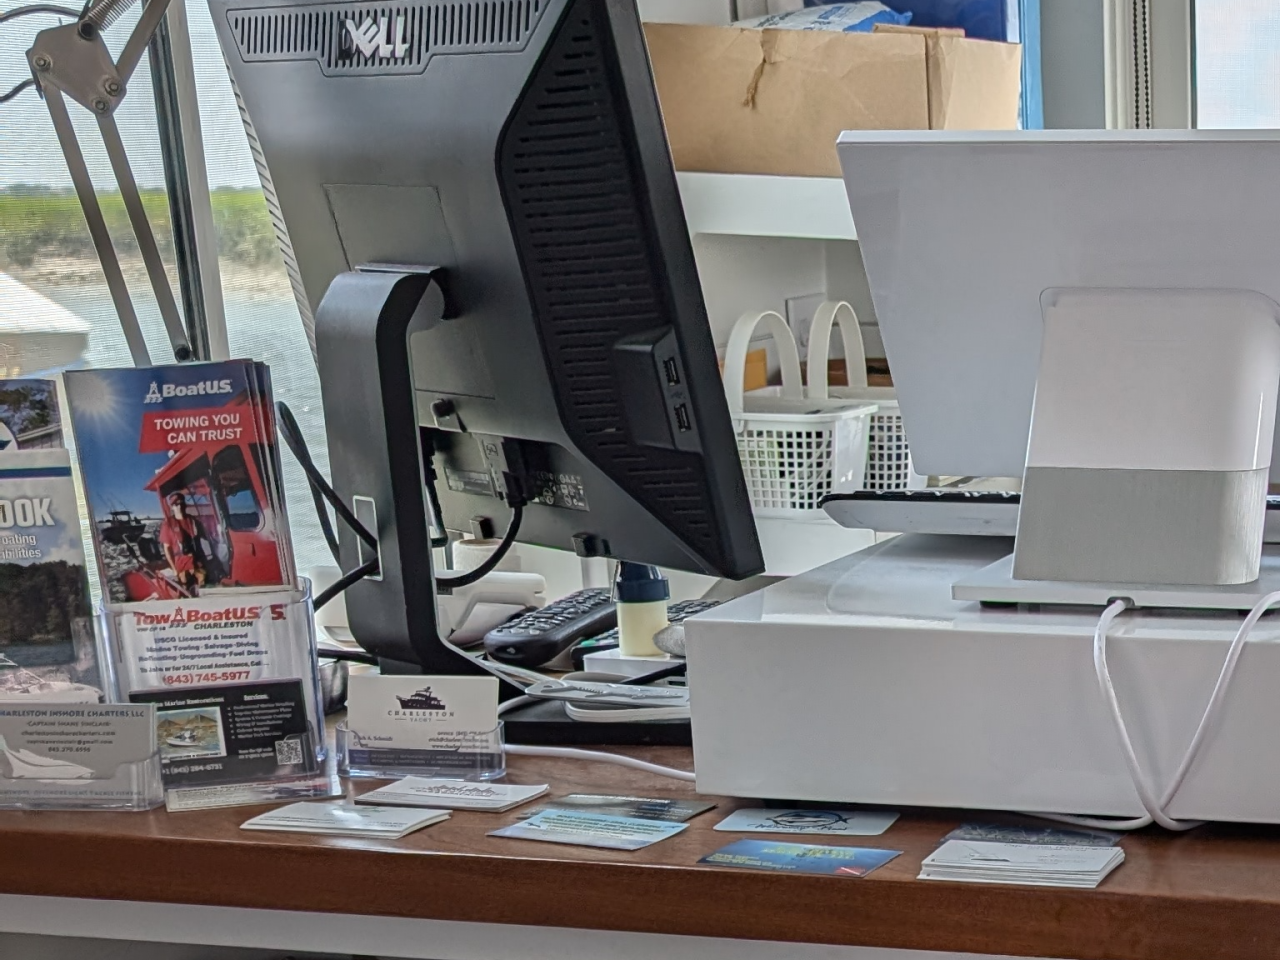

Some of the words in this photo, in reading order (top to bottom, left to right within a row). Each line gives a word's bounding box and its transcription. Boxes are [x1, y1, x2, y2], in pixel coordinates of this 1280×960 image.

[338, 15, 410, 61] DELL
[154, 415, 209, 431] TOWING
[211, 413, 240, 428] YOU
[167, 430, 196, 444] CAN
[199, 428, 242, 442] TRUST
[134, 610, 171, 626] Tow
[194, 621, 253, 630] CHARLESTON
[178, 634, 212, 643] Licensed
[220, 632, 248, 640] Insured
[172, 644, 200, 653] Towing
[163, 673, 193, 686] (843)
[196, 671, 250, 683] 745-5977
[87, 709, 129, 718] CHARTERS
[131, 710, 145, 718] LLC
[387, 710, 455, 718] CHARLESTON
